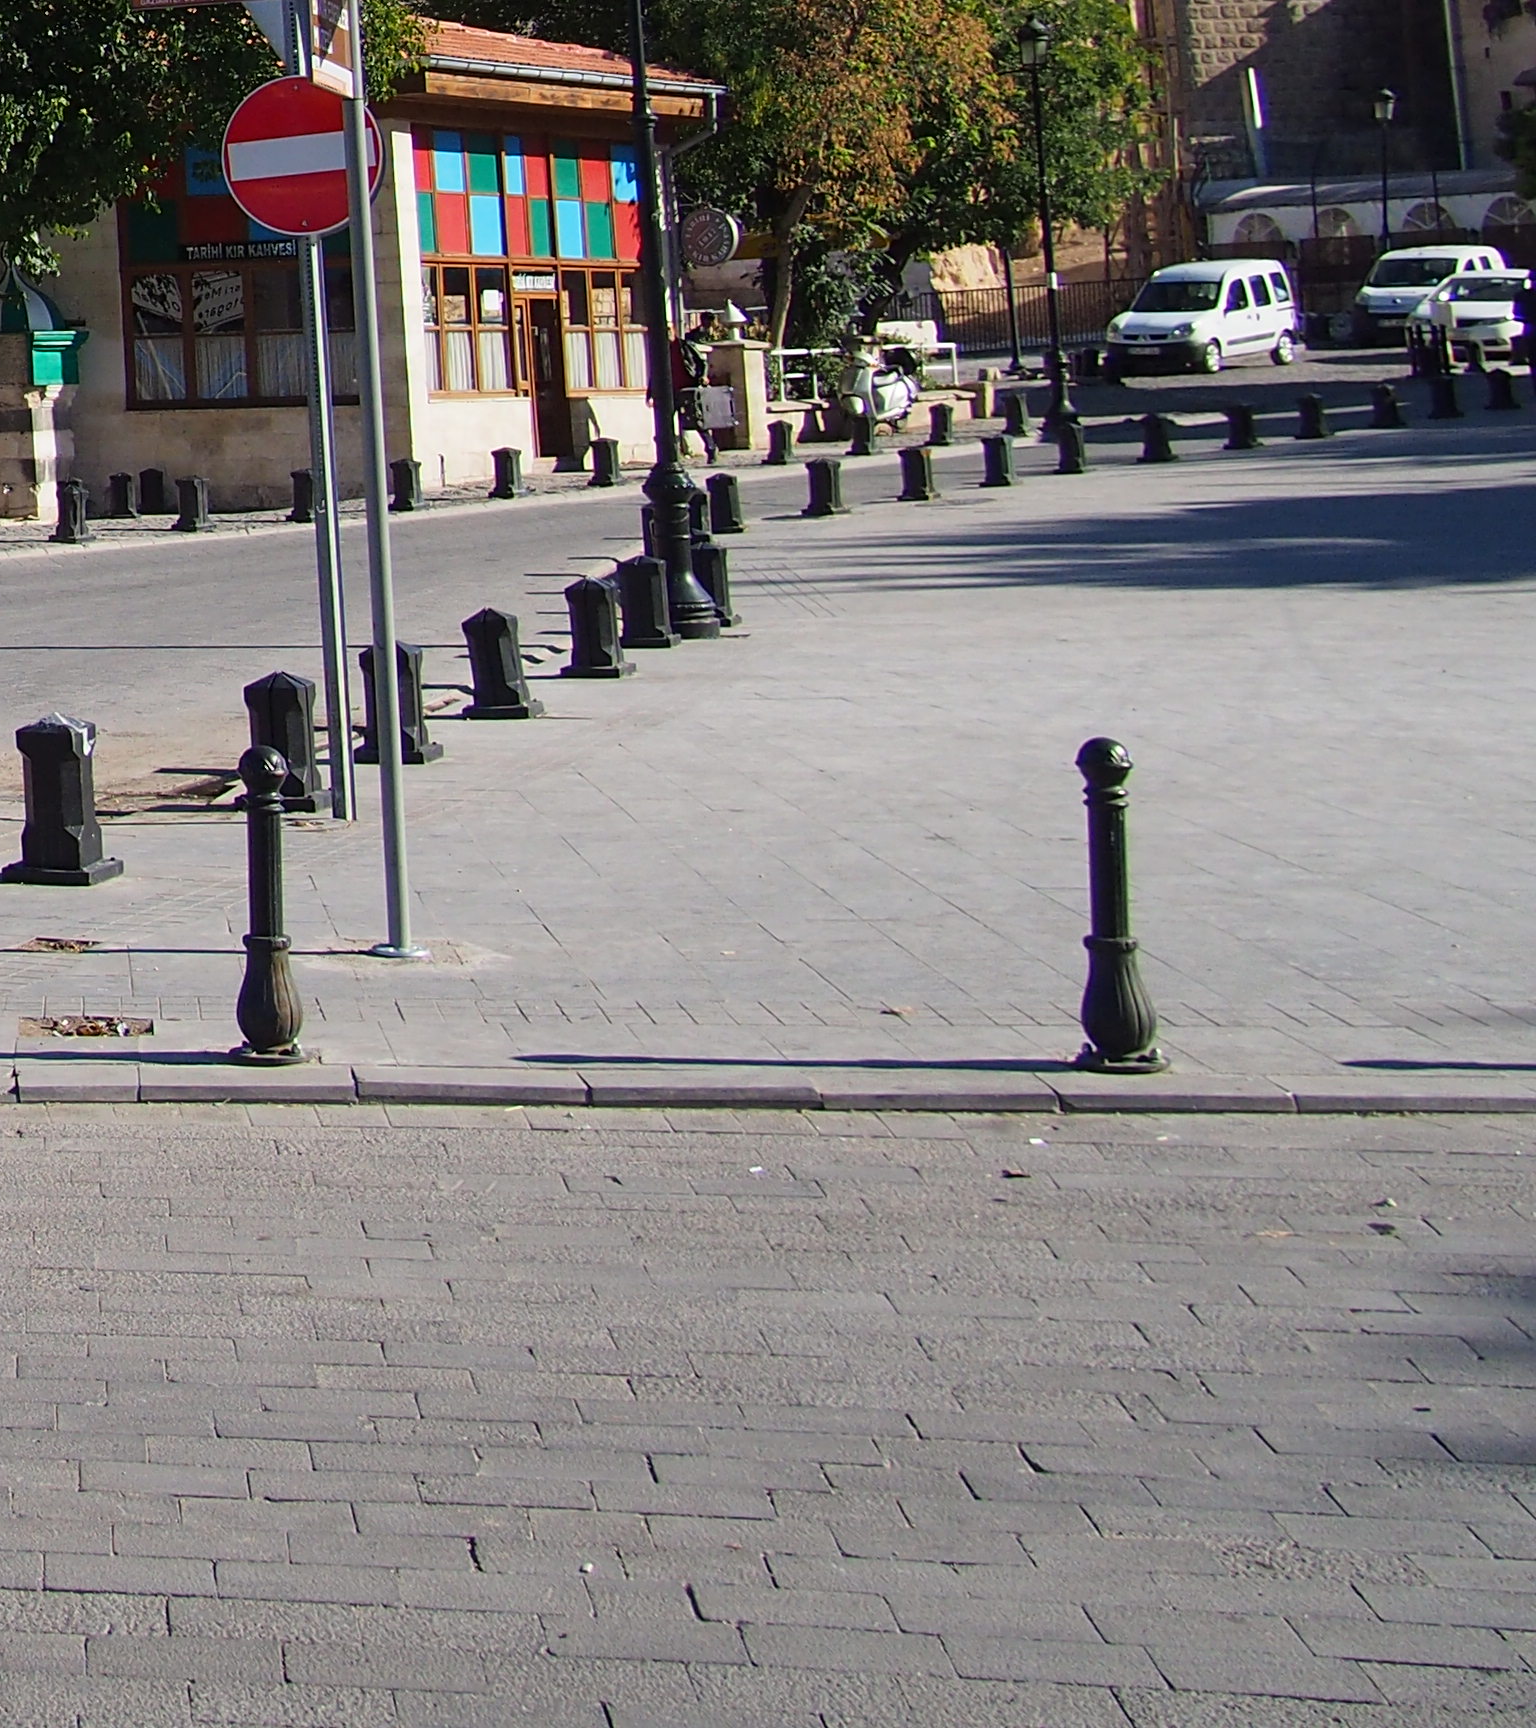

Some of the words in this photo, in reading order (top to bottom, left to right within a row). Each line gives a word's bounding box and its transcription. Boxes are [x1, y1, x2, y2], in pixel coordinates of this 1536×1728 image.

[186, 243, 222, 260] TARİHİ
[226, 245, 244, 258] KIR
[248, 239, 296, 257] KAHVESİ
